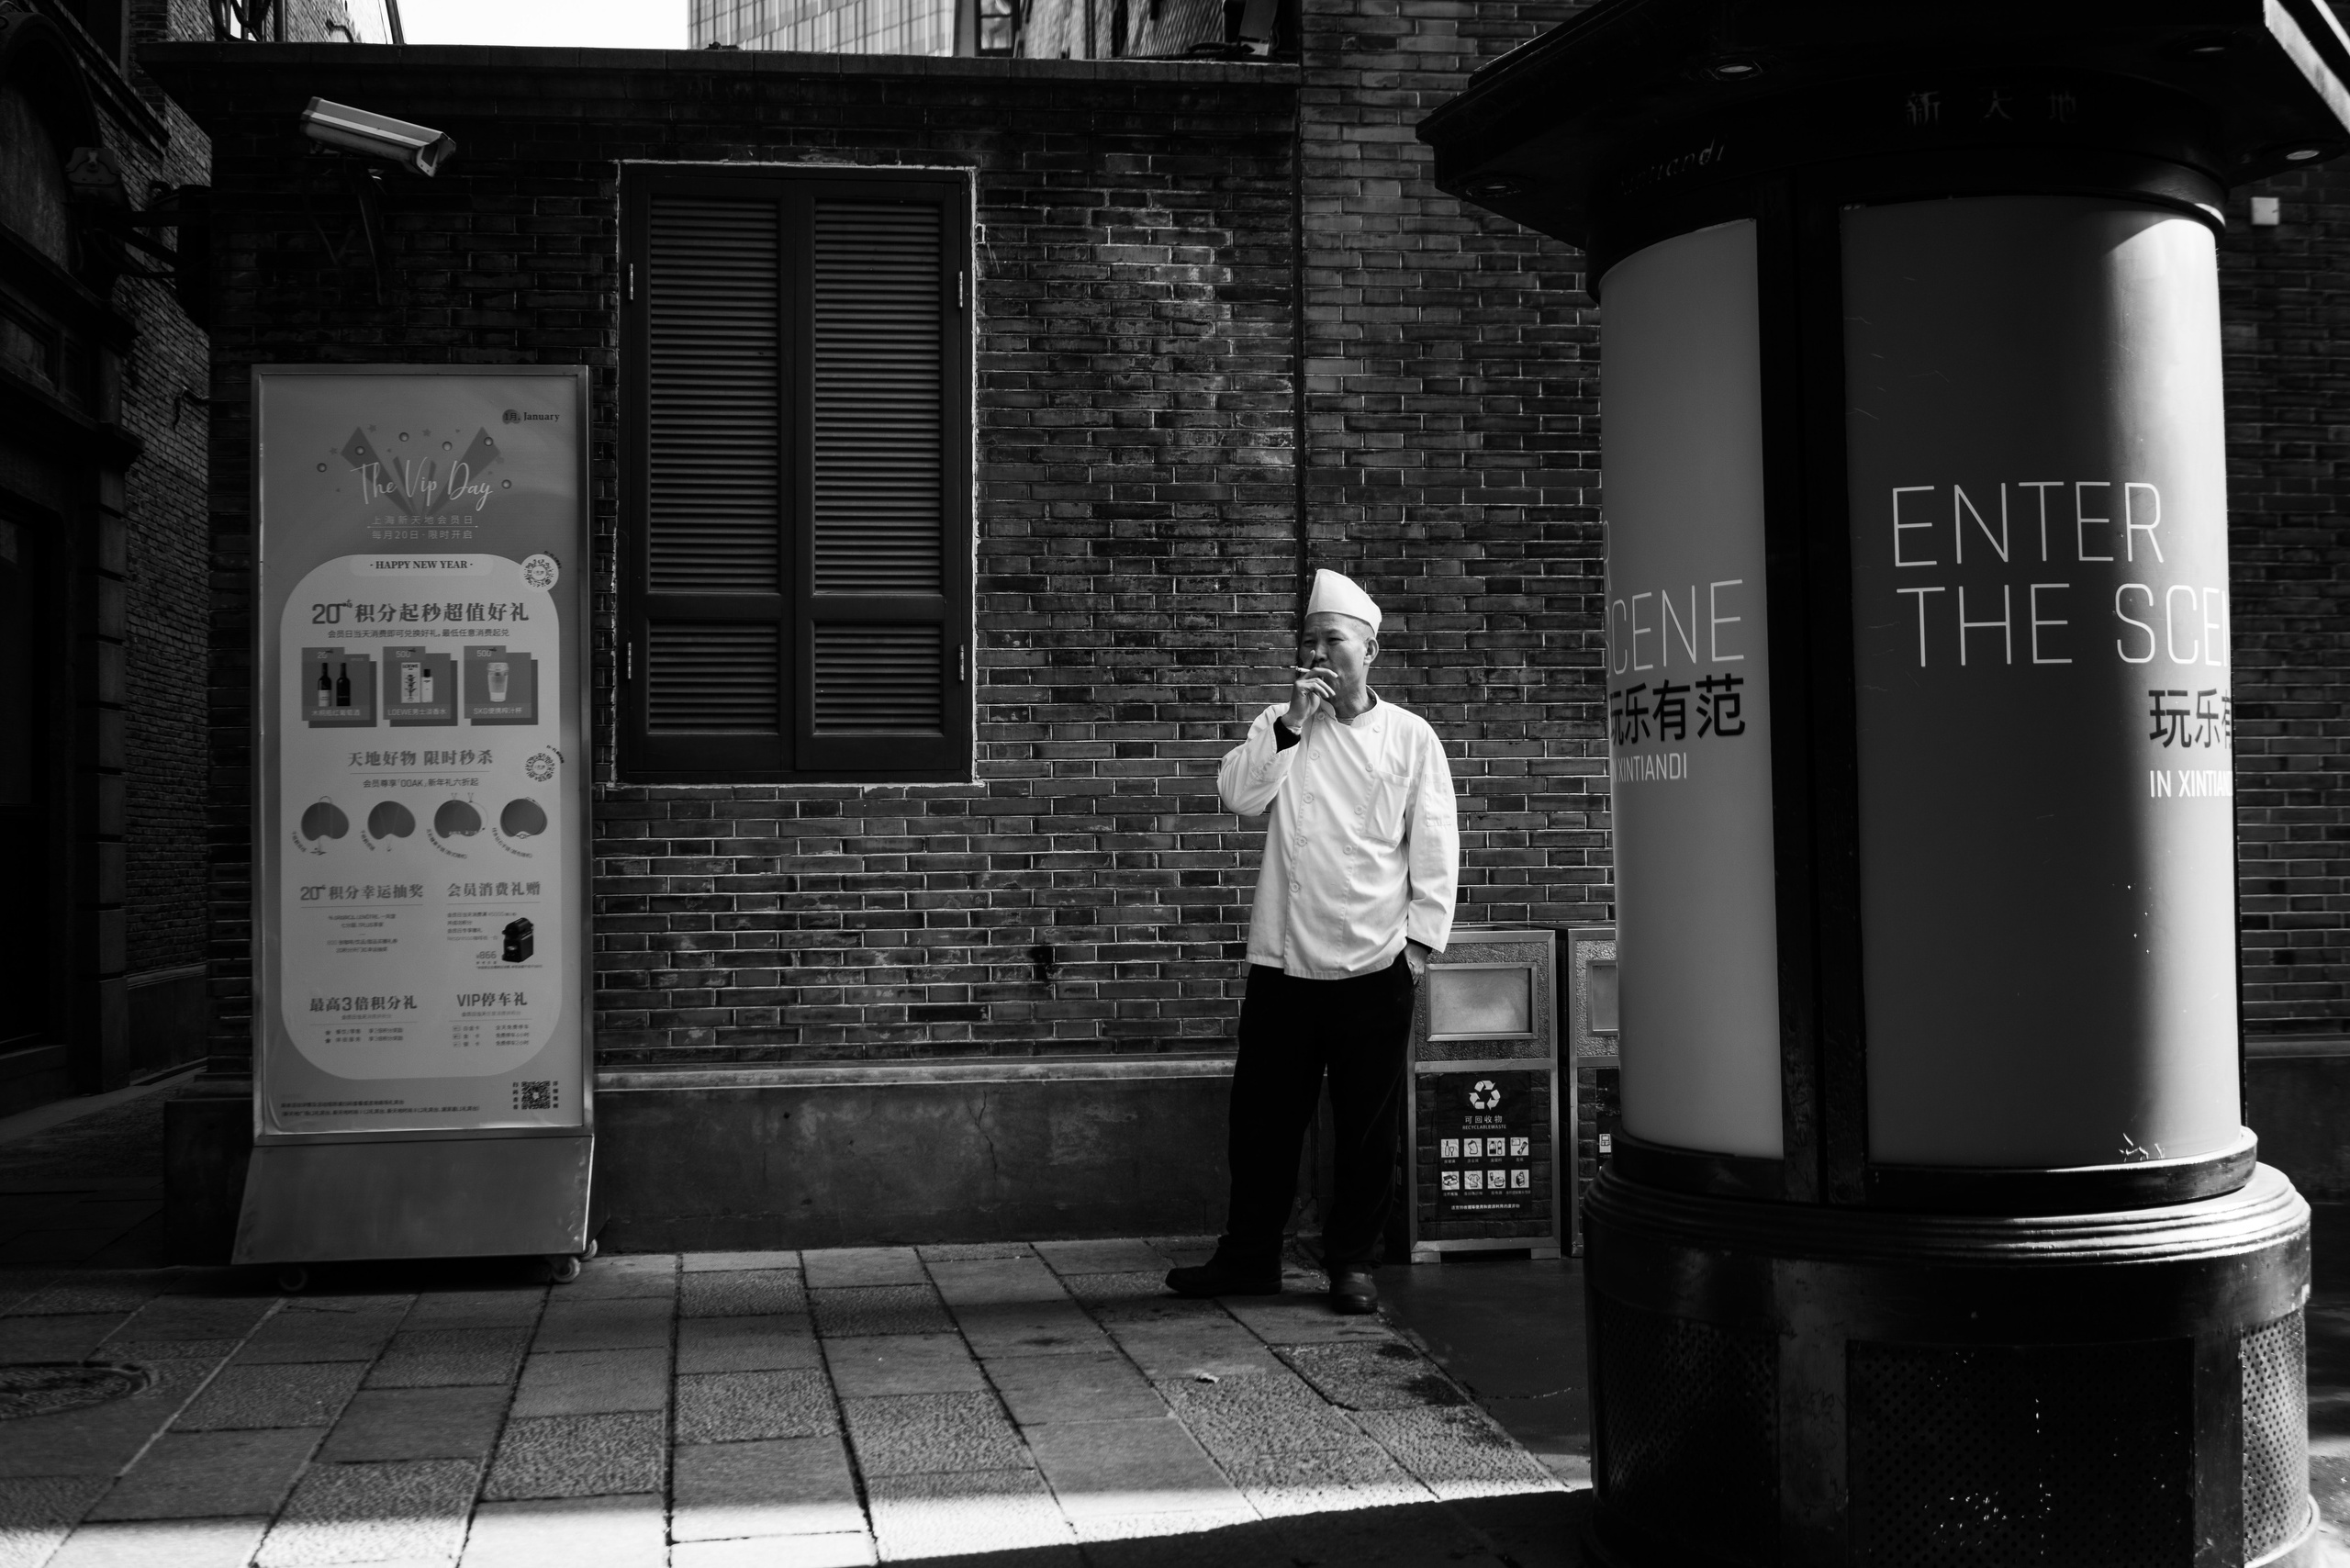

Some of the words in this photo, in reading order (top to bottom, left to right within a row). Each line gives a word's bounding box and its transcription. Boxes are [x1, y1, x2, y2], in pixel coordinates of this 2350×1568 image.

[1903, 89, 2078, 125] 新天地
[523, 411, 560, 422] January
[350, 461, 397, 505] The
[406, 456, 438, 507] Vip
[447, 461, 494, 511] Day
[372, 515, 473, 525] 上海新天地会员日
[1893, 482, 2165, 567] ENTER
[375, 560, 410, 569] HAPPY
[412, 560, 439, 569] NEW
[441, 560, 468, 569] YEAR
[354, 602, 530, 622] 积分起秒超值好礼
[1897, 583, 2073, 667] THE
[395, 650, 411, 658] 500
[476, 649, 493, 657] 500
[347, 750, 416, 767] 天地好物
[423, 749, 493, 766] 限时秒杀
[1617, 752, 1687, 783] XINTIANDI
[2150, 769, 2172, 798] IN
[329, 884, 424, 901] 积分幸运抽奖
[447, 881, 542, 899] 会员消费礼赠
[309, 994, 418, 1013] 最高3倍积分礼
[457, 991, 528, 1007] VIP停车礼
[1465, 1114, 1503, 1124] 可回收物
